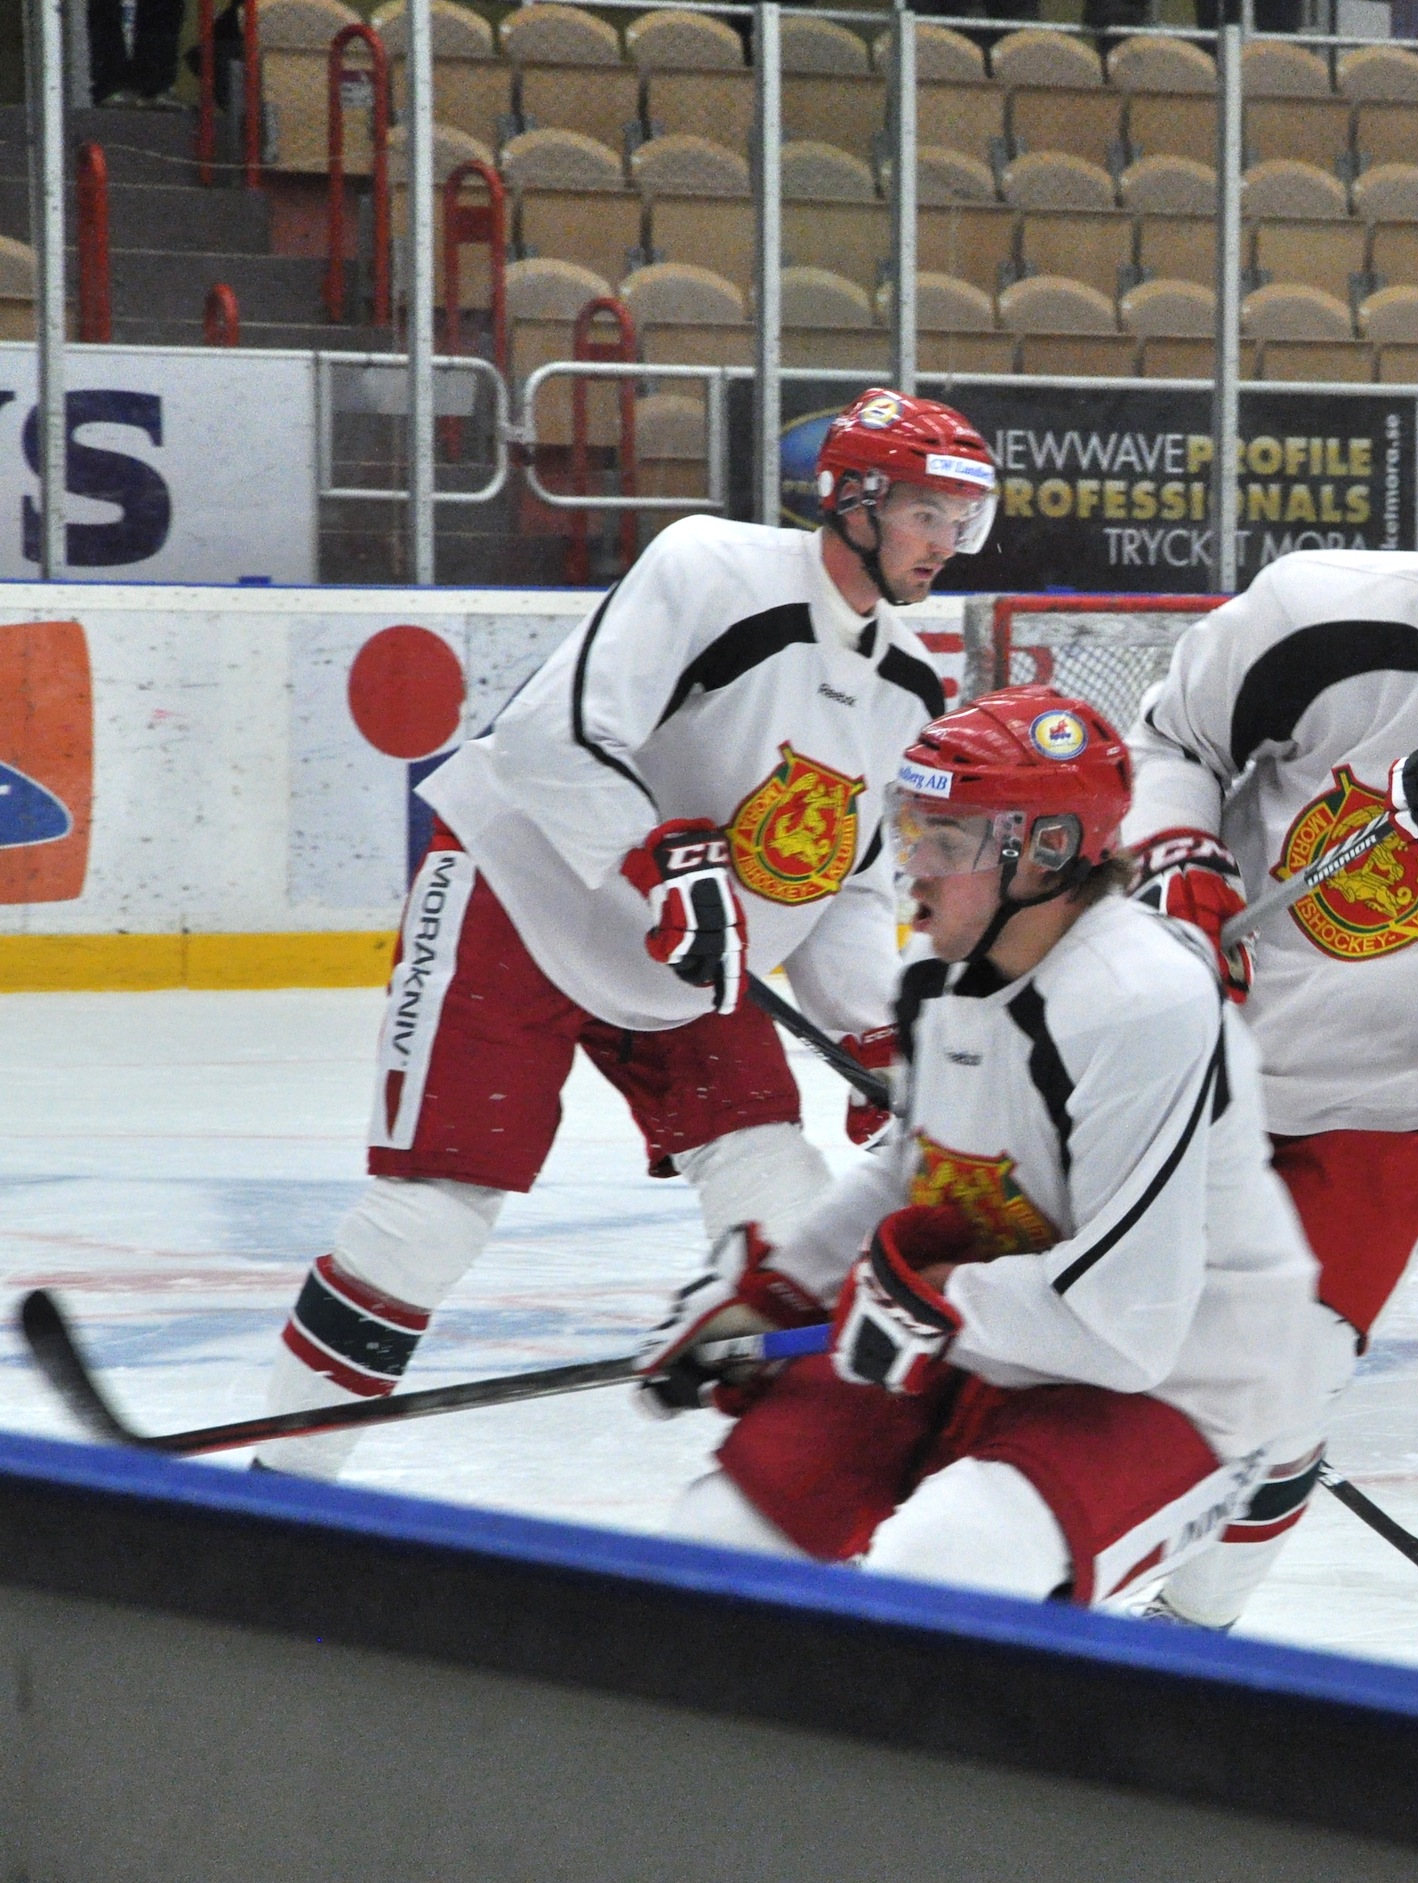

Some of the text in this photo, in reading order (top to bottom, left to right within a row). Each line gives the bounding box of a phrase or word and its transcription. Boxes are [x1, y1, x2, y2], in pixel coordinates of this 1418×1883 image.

[992, 477, 1372, 523] ROFESSINALS
[926, 774, 949, 792] AB
[1290, 812, 1328, 868] MORA
[392, 855, 456, 1057] MORAKNIV
